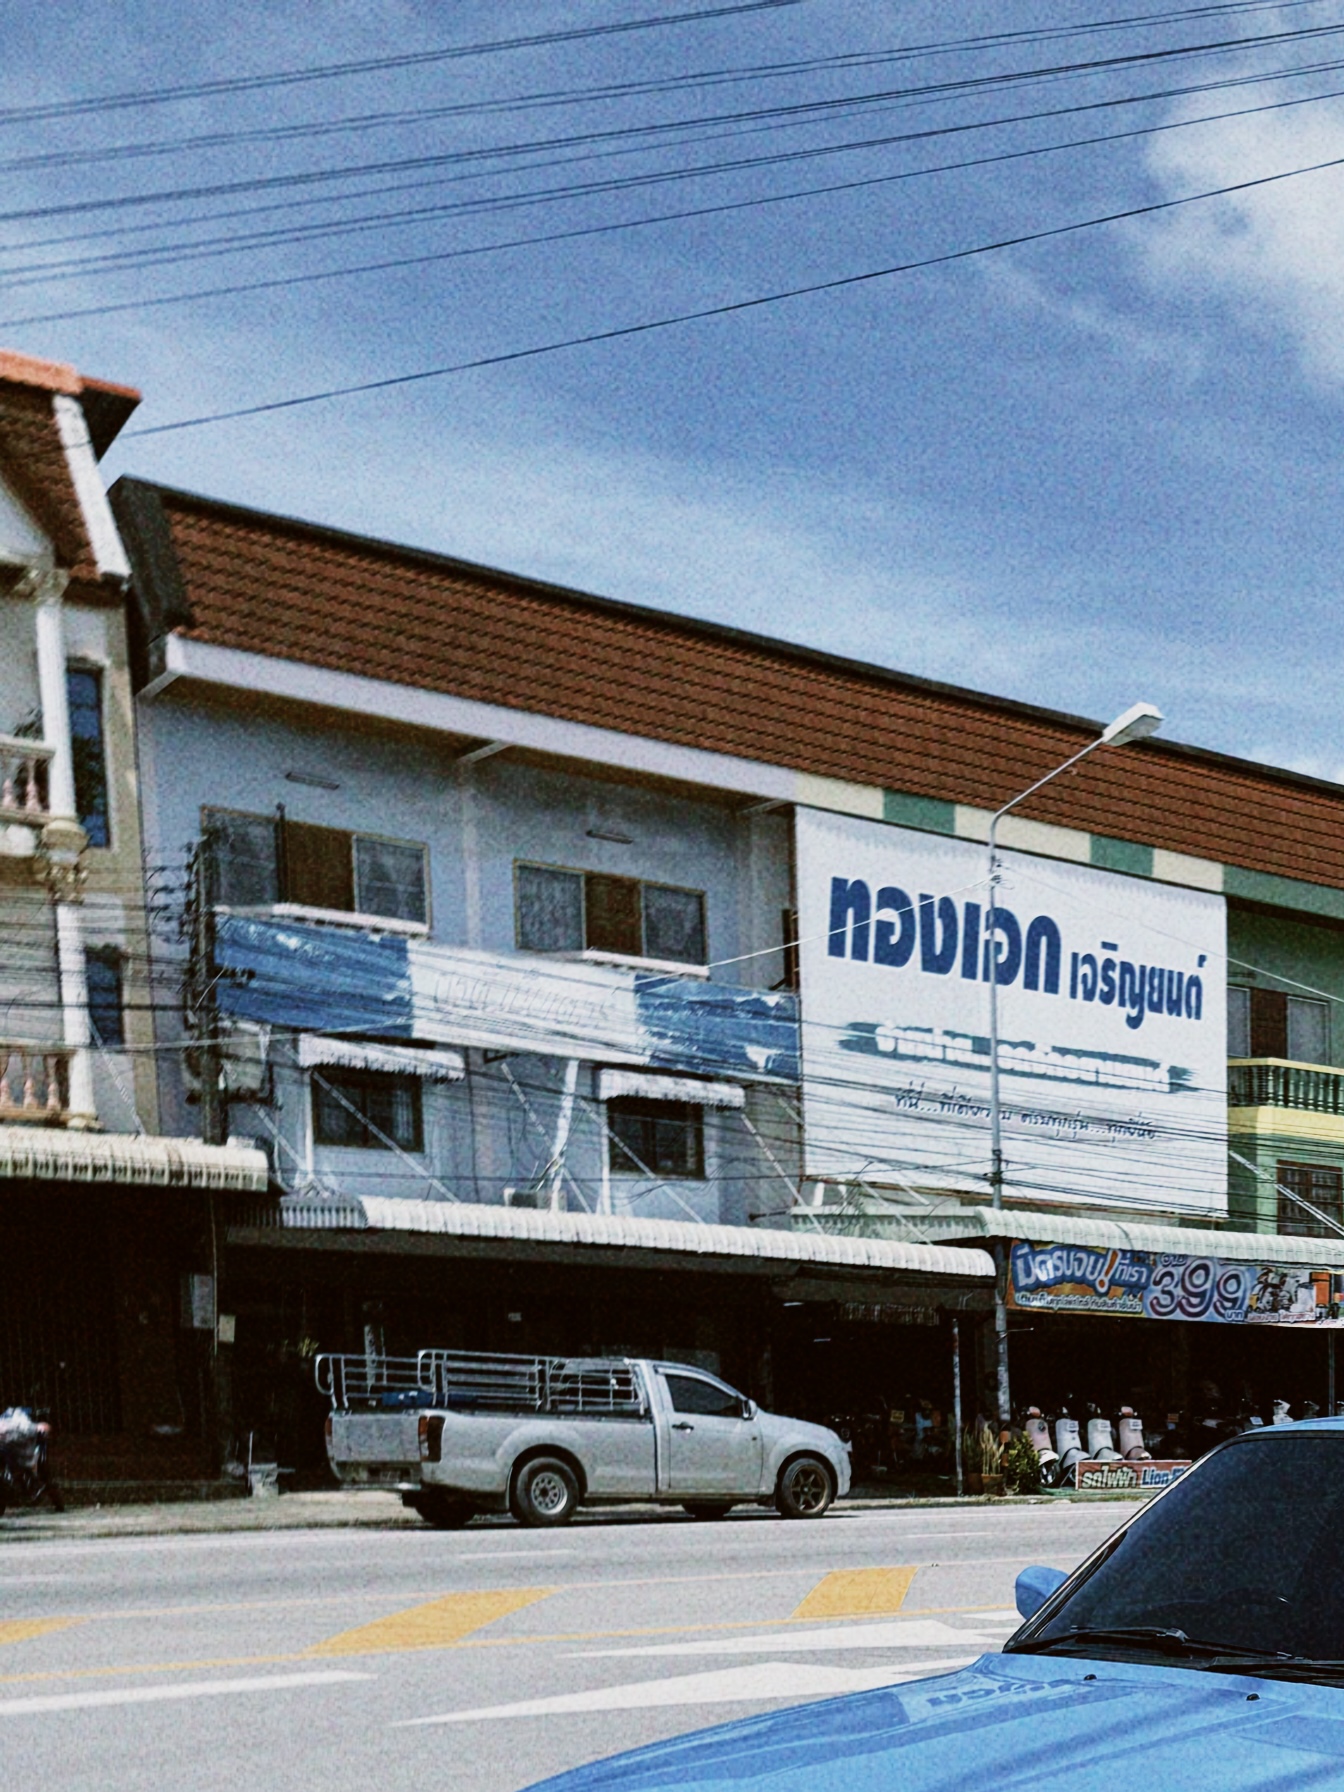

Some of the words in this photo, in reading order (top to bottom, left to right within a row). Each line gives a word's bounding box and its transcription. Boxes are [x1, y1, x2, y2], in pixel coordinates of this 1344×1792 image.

[827, 875, 1062, 996] ทองเอก
[1069, 941, 1207, 1030] เจริญยนต์
[1149, 1257, 1246, 1319] 399
